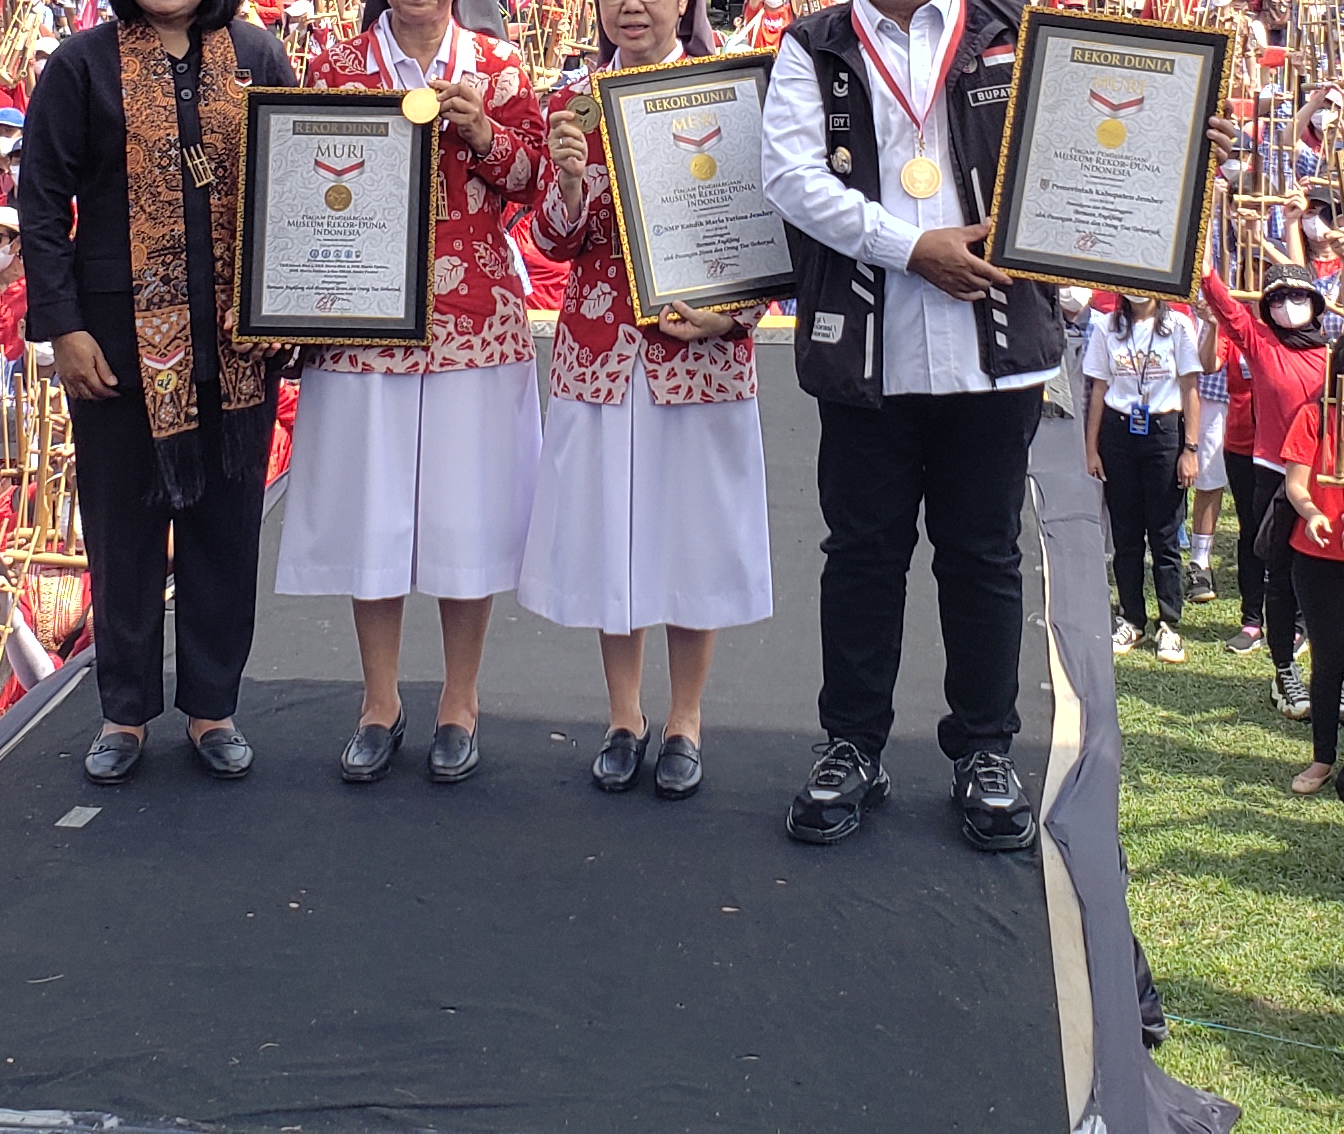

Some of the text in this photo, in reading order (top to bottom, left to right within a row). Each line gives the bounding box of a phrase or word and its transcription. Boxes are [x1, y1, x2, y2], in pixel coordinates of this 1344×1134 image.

[1074, 49, 1172, 72] REKOR DUNIA
[1093, 74, 1146, 95] MURI
[646, 90, 735, 112] REKOR DUNIA
[977, 88, 1011, 101] BUPAT
[296, 122, 387, 135] REKOR DUNIA
[316, 144, 364, 158] MURI
[1080, 162, 1131, 177] INDONESIA
[1096, 157, 1162, 174] REKOR-DUNIA
[661, 183, 757, 204] MUSEUM REKOR-DUNIA
[687, 195, 733, 207] INDONESIA
[287, 220, 387, 229] MUSEUM REKOR-DUNIA
[313, 227, 361, 236] INDONESIA
